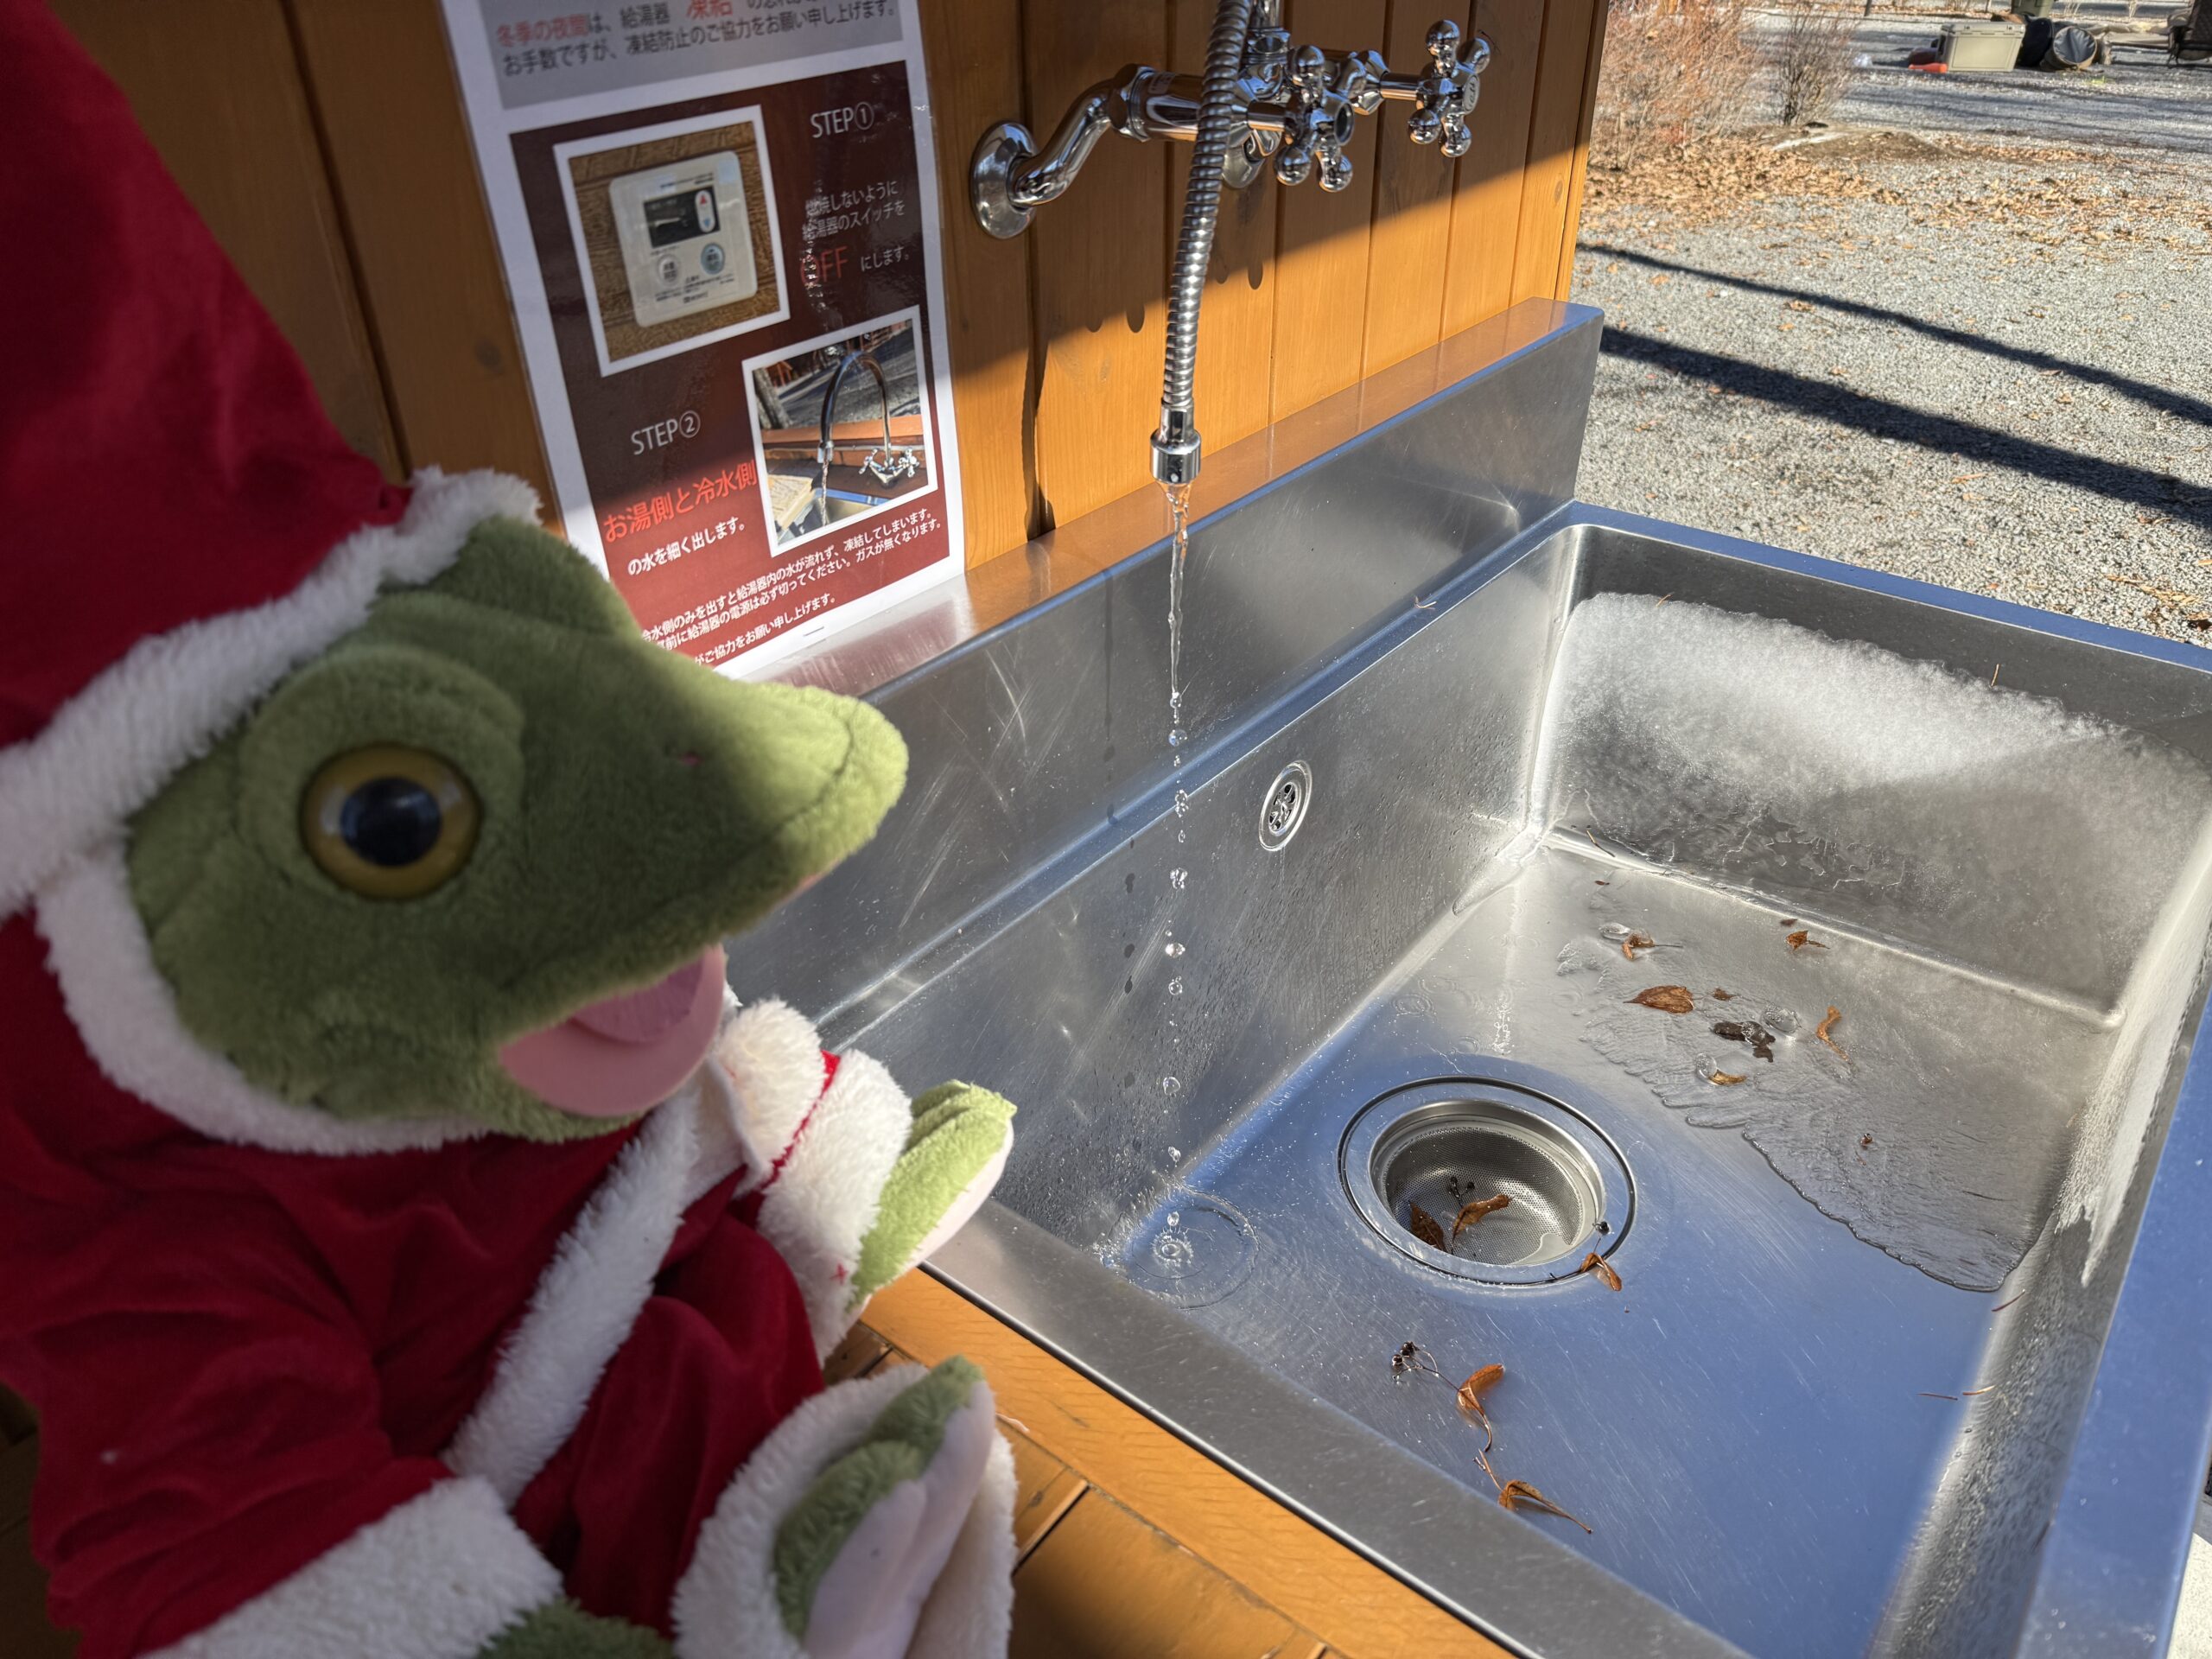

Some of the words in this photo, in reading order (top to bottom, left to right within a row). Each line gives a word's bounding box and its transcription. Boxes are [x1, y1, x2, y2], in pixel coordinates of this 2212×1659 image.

[800, 245, 849, 285] OFF
[860, 245, 910, 272] にします。
[604, 460, 758, 543] お湯側と冷水側
[628, 516, 745, 575] の水を細く出します。
